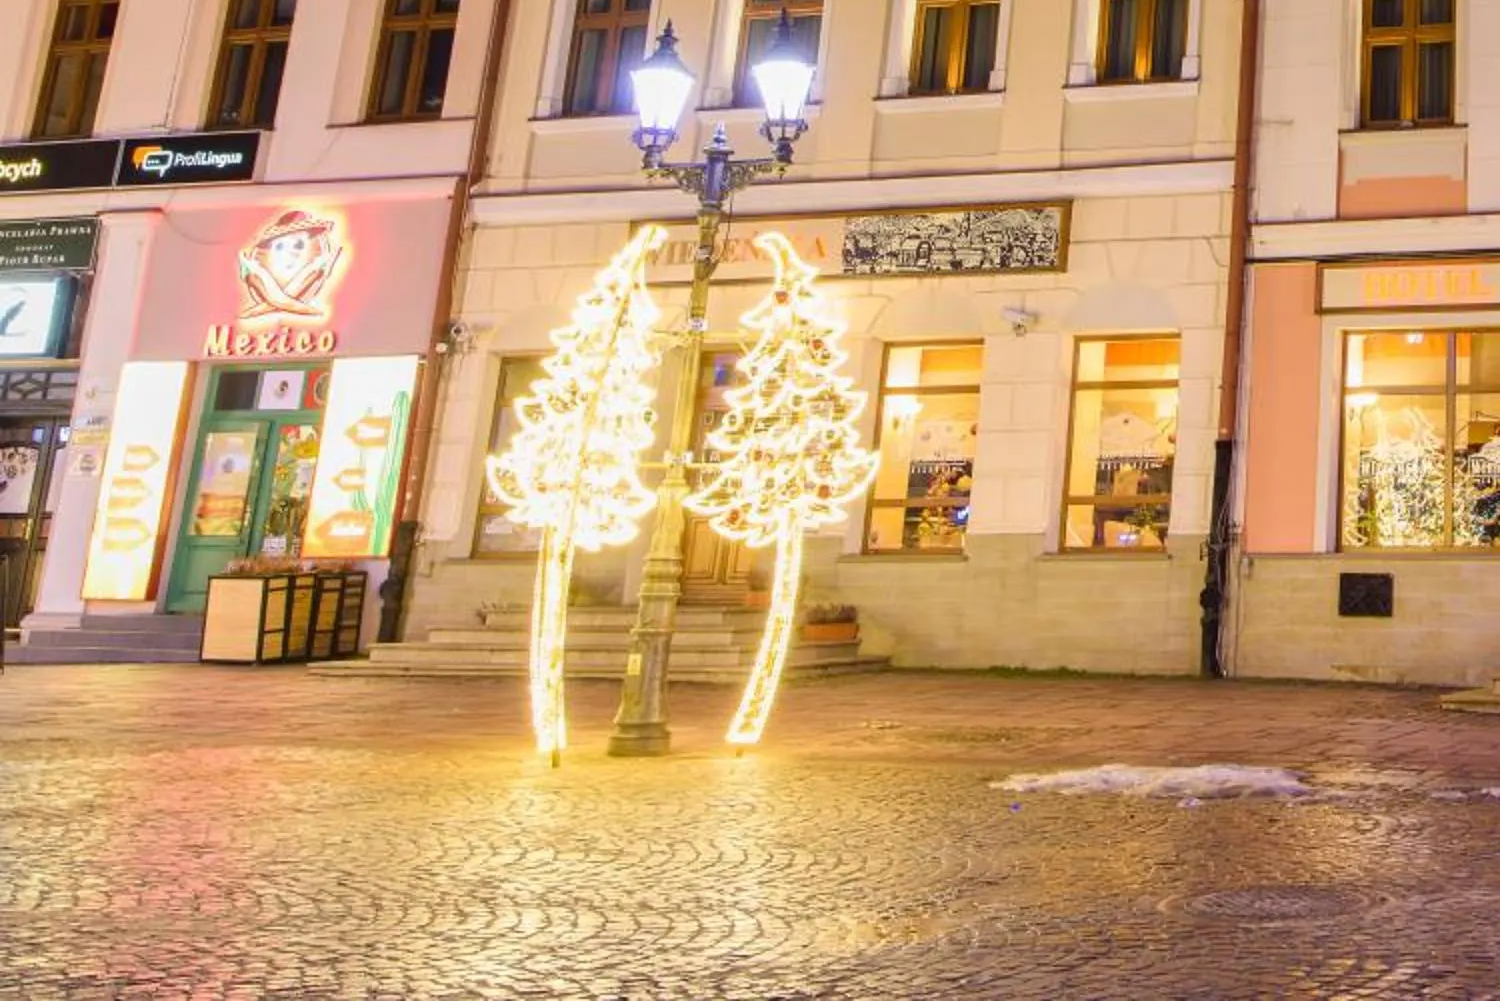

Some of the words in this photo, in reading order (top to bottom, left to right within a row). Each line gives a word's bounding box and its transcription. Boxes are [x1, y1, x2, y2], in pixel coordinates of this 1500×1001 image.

[174, 151, 243, 167] ProfiLingua
[1364, 269, 1492, 300] HOTEL
[204, 325, 337, 356] Mexico
